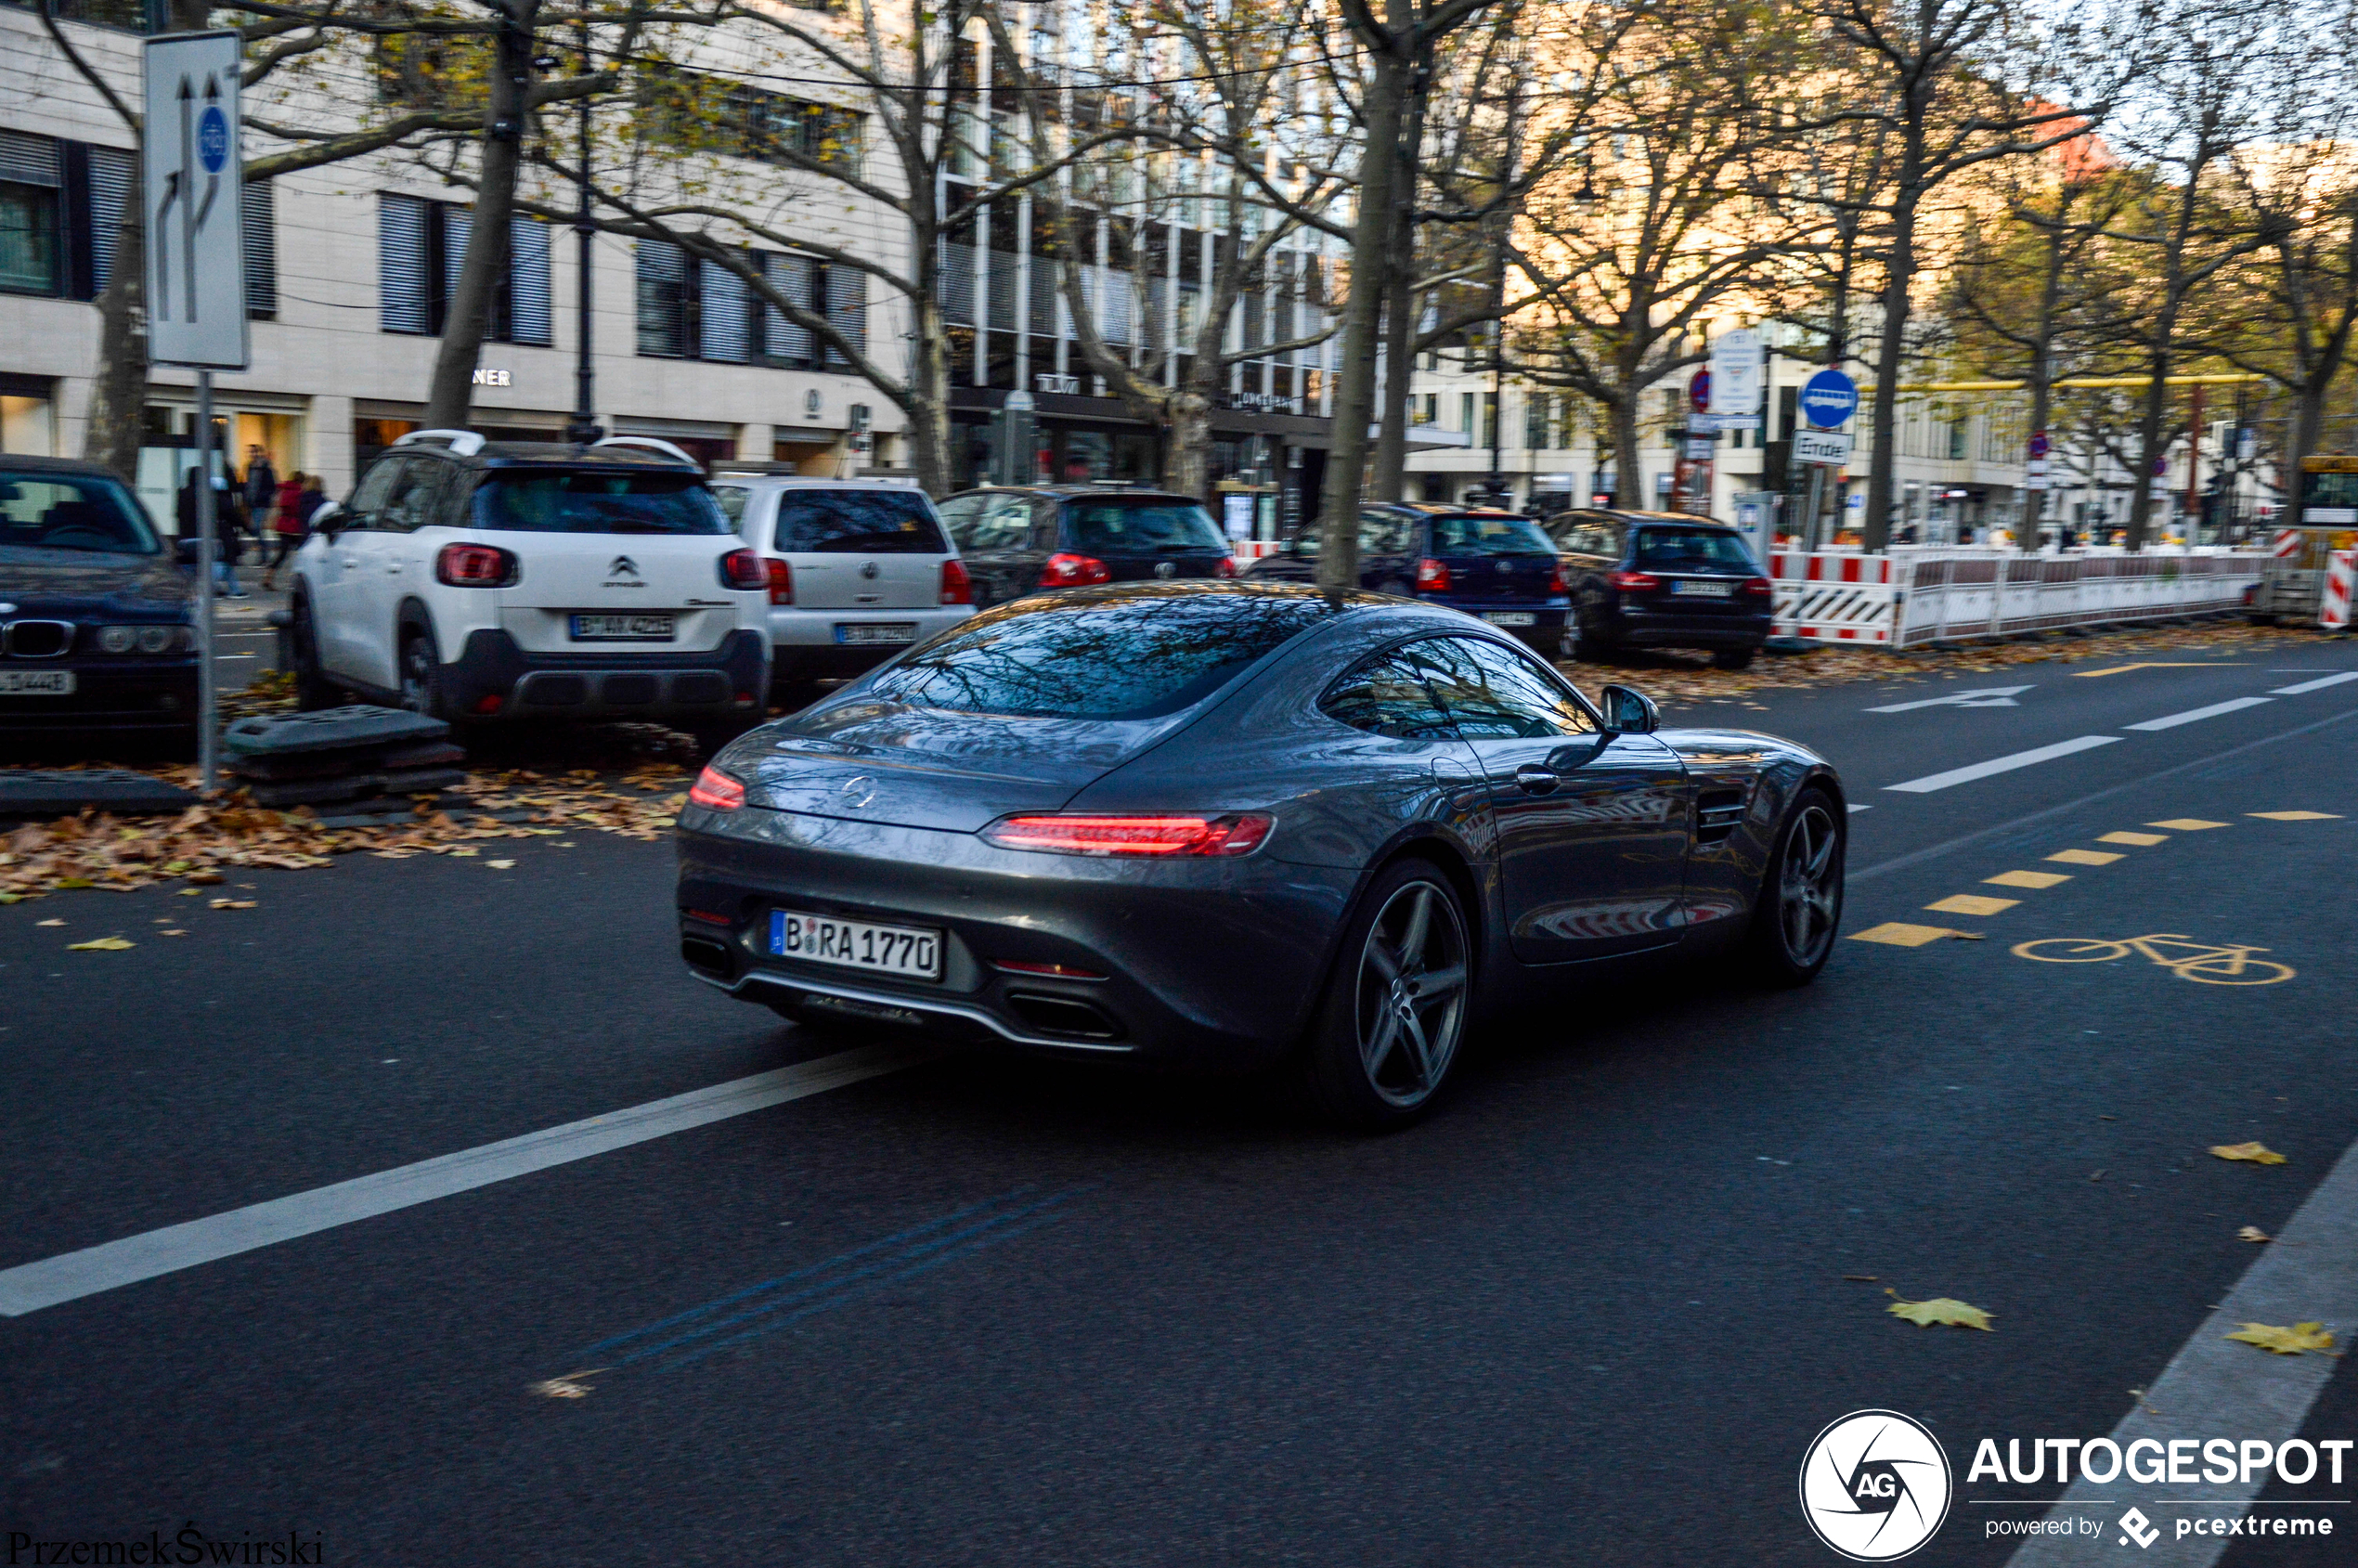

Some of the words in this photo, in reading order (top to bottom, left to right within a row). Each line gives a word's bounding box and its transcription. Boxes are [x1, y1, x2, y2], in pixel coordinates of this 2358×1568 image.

[473, 369, 511, 387] NER
[1797, 437, 1845, 458] Ende
[579, 617, 591, 634] B
[786, 917, 802, 952] B
[819, 923, 854, 961] RA
[860, 929, 934, 971] 1770
